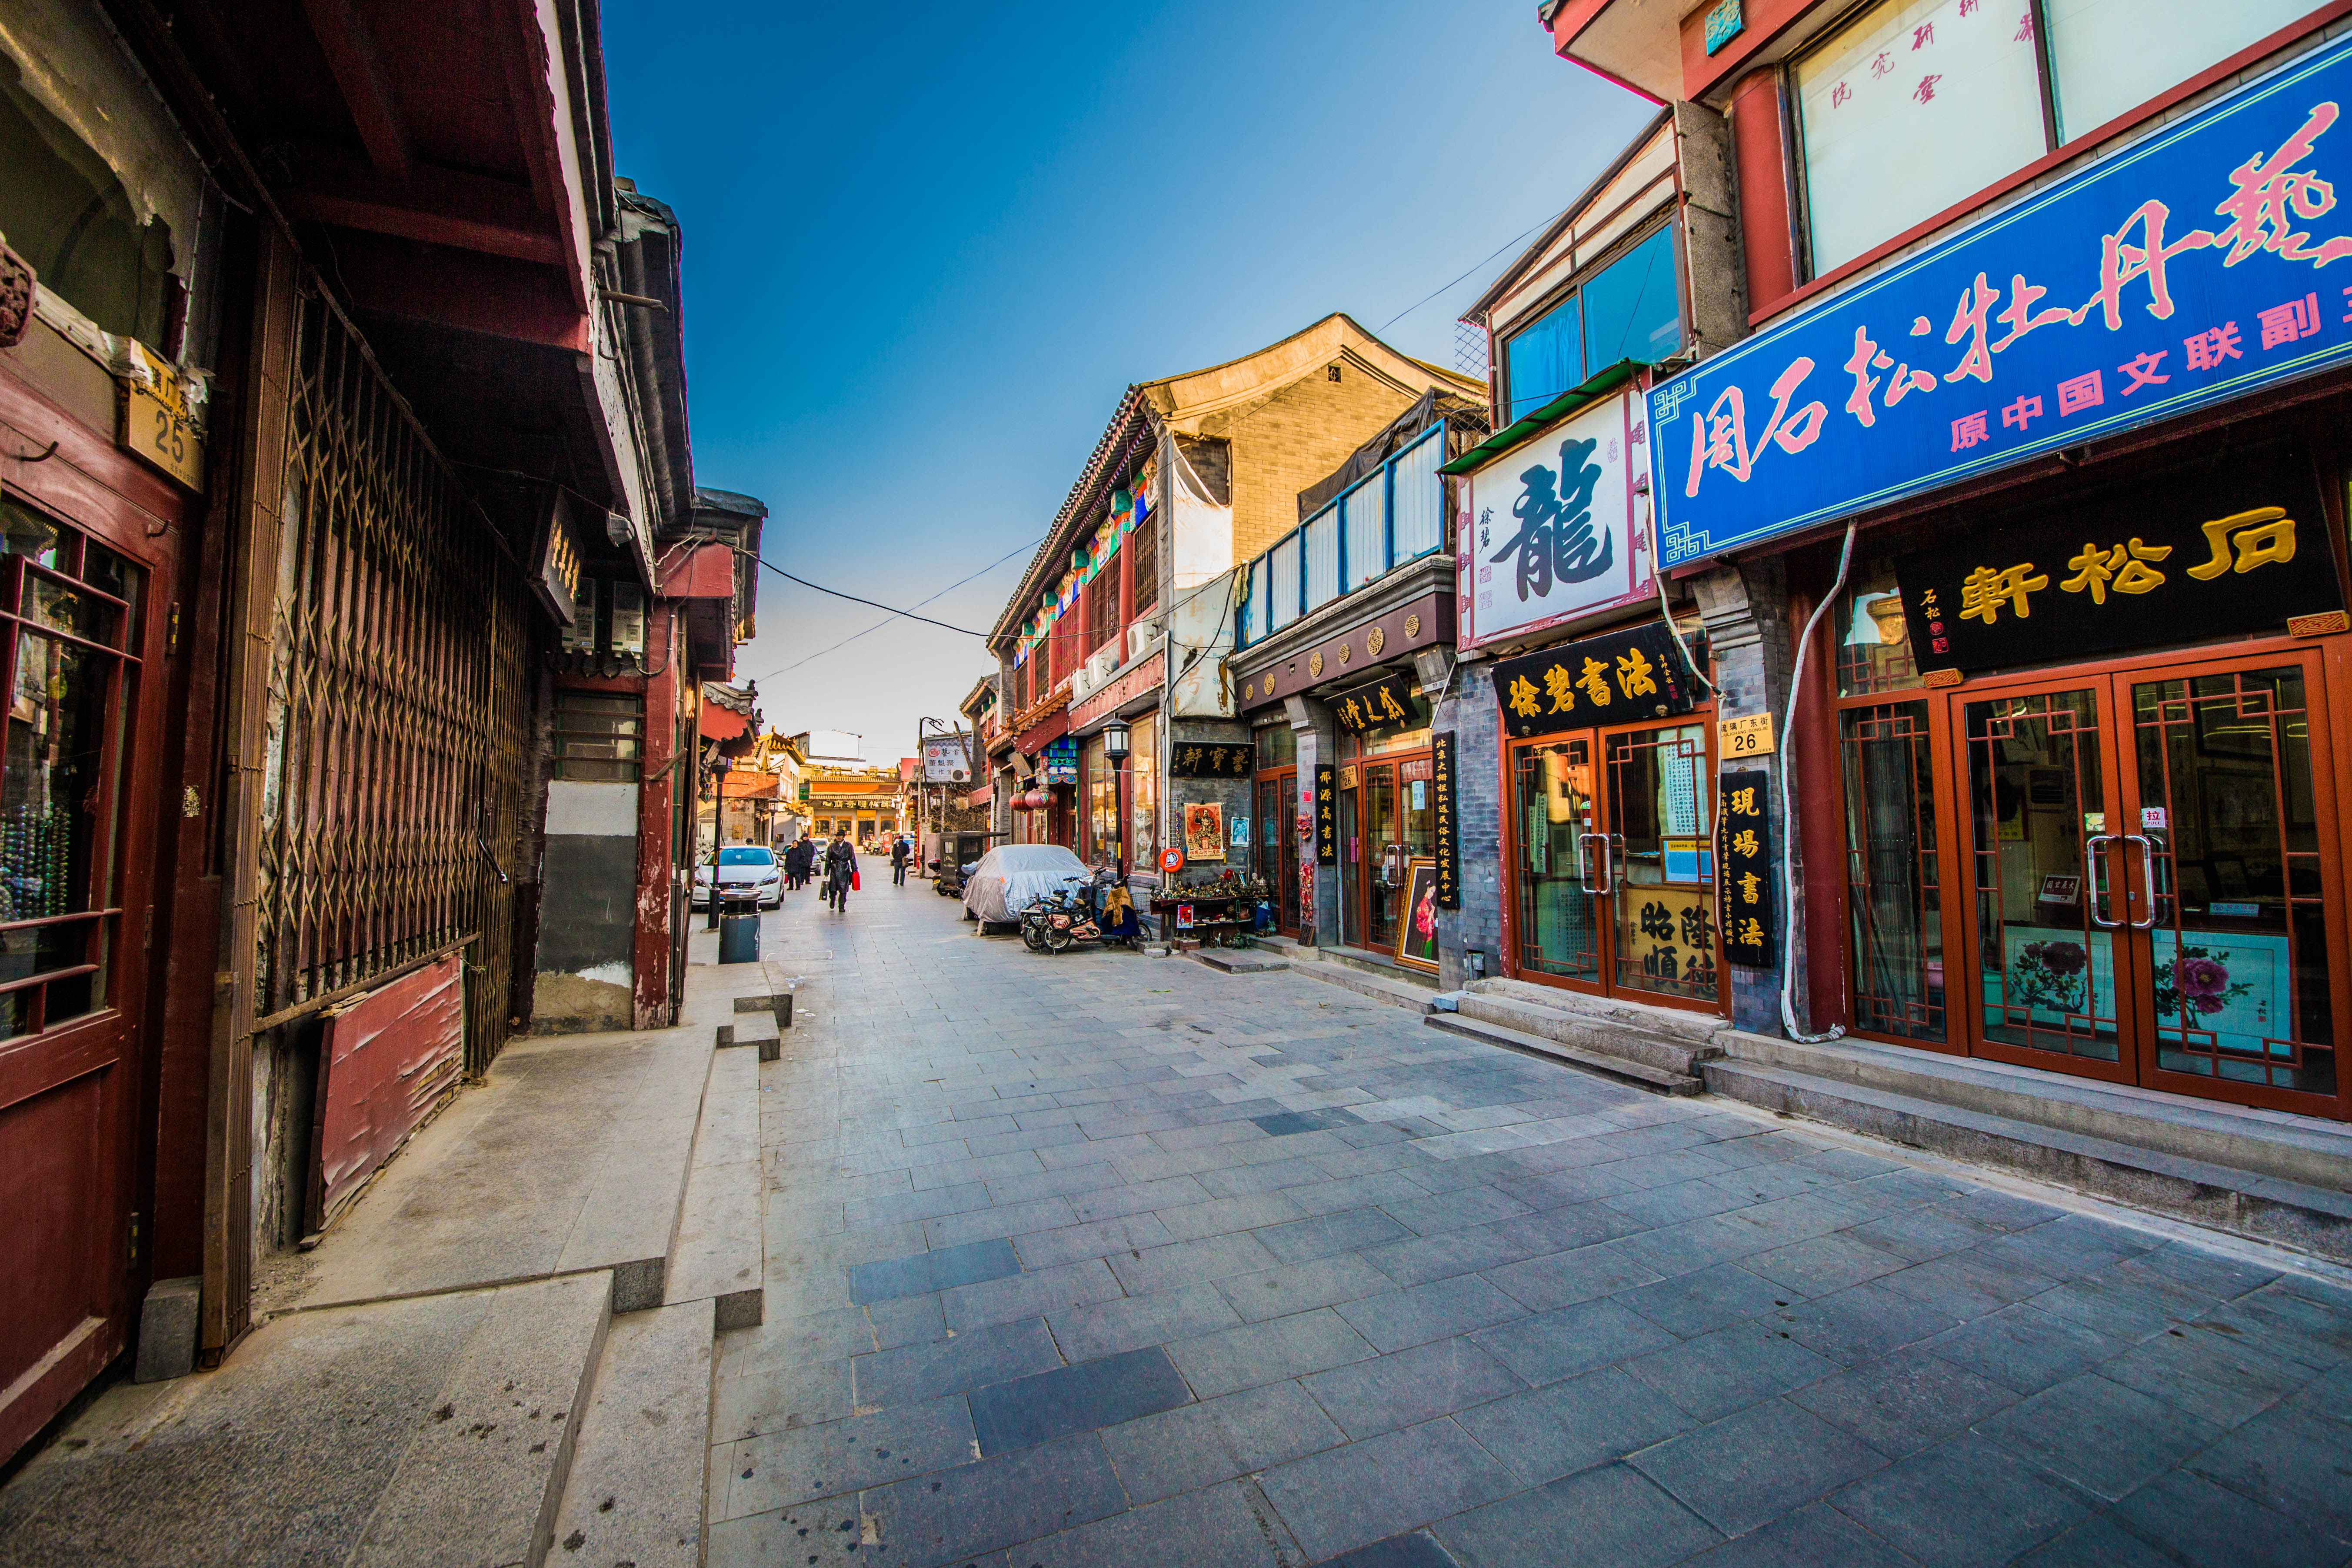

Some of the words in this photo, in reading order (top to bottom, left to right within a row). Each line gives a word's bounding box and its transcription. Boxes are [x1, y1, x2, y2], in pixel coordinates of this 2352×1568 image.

[156, 410, 184, 463] 25
[1479, 506, 1494, 554] 徐碧
[1490, 437, 1613, 603] 龍
[1959, 506, 2297, 624] 石松軒
[1919, 588, 1940, 620] 石松
[1509, 647, 1657, 718] 徐碧書法
[1735, 733, 1756, 752] 26
[1319, 770, 1334, 858] 邢源高書法
[2146, 810, 2161, 821] 拉
[1731, 787, 1765, 947] 現場書法
